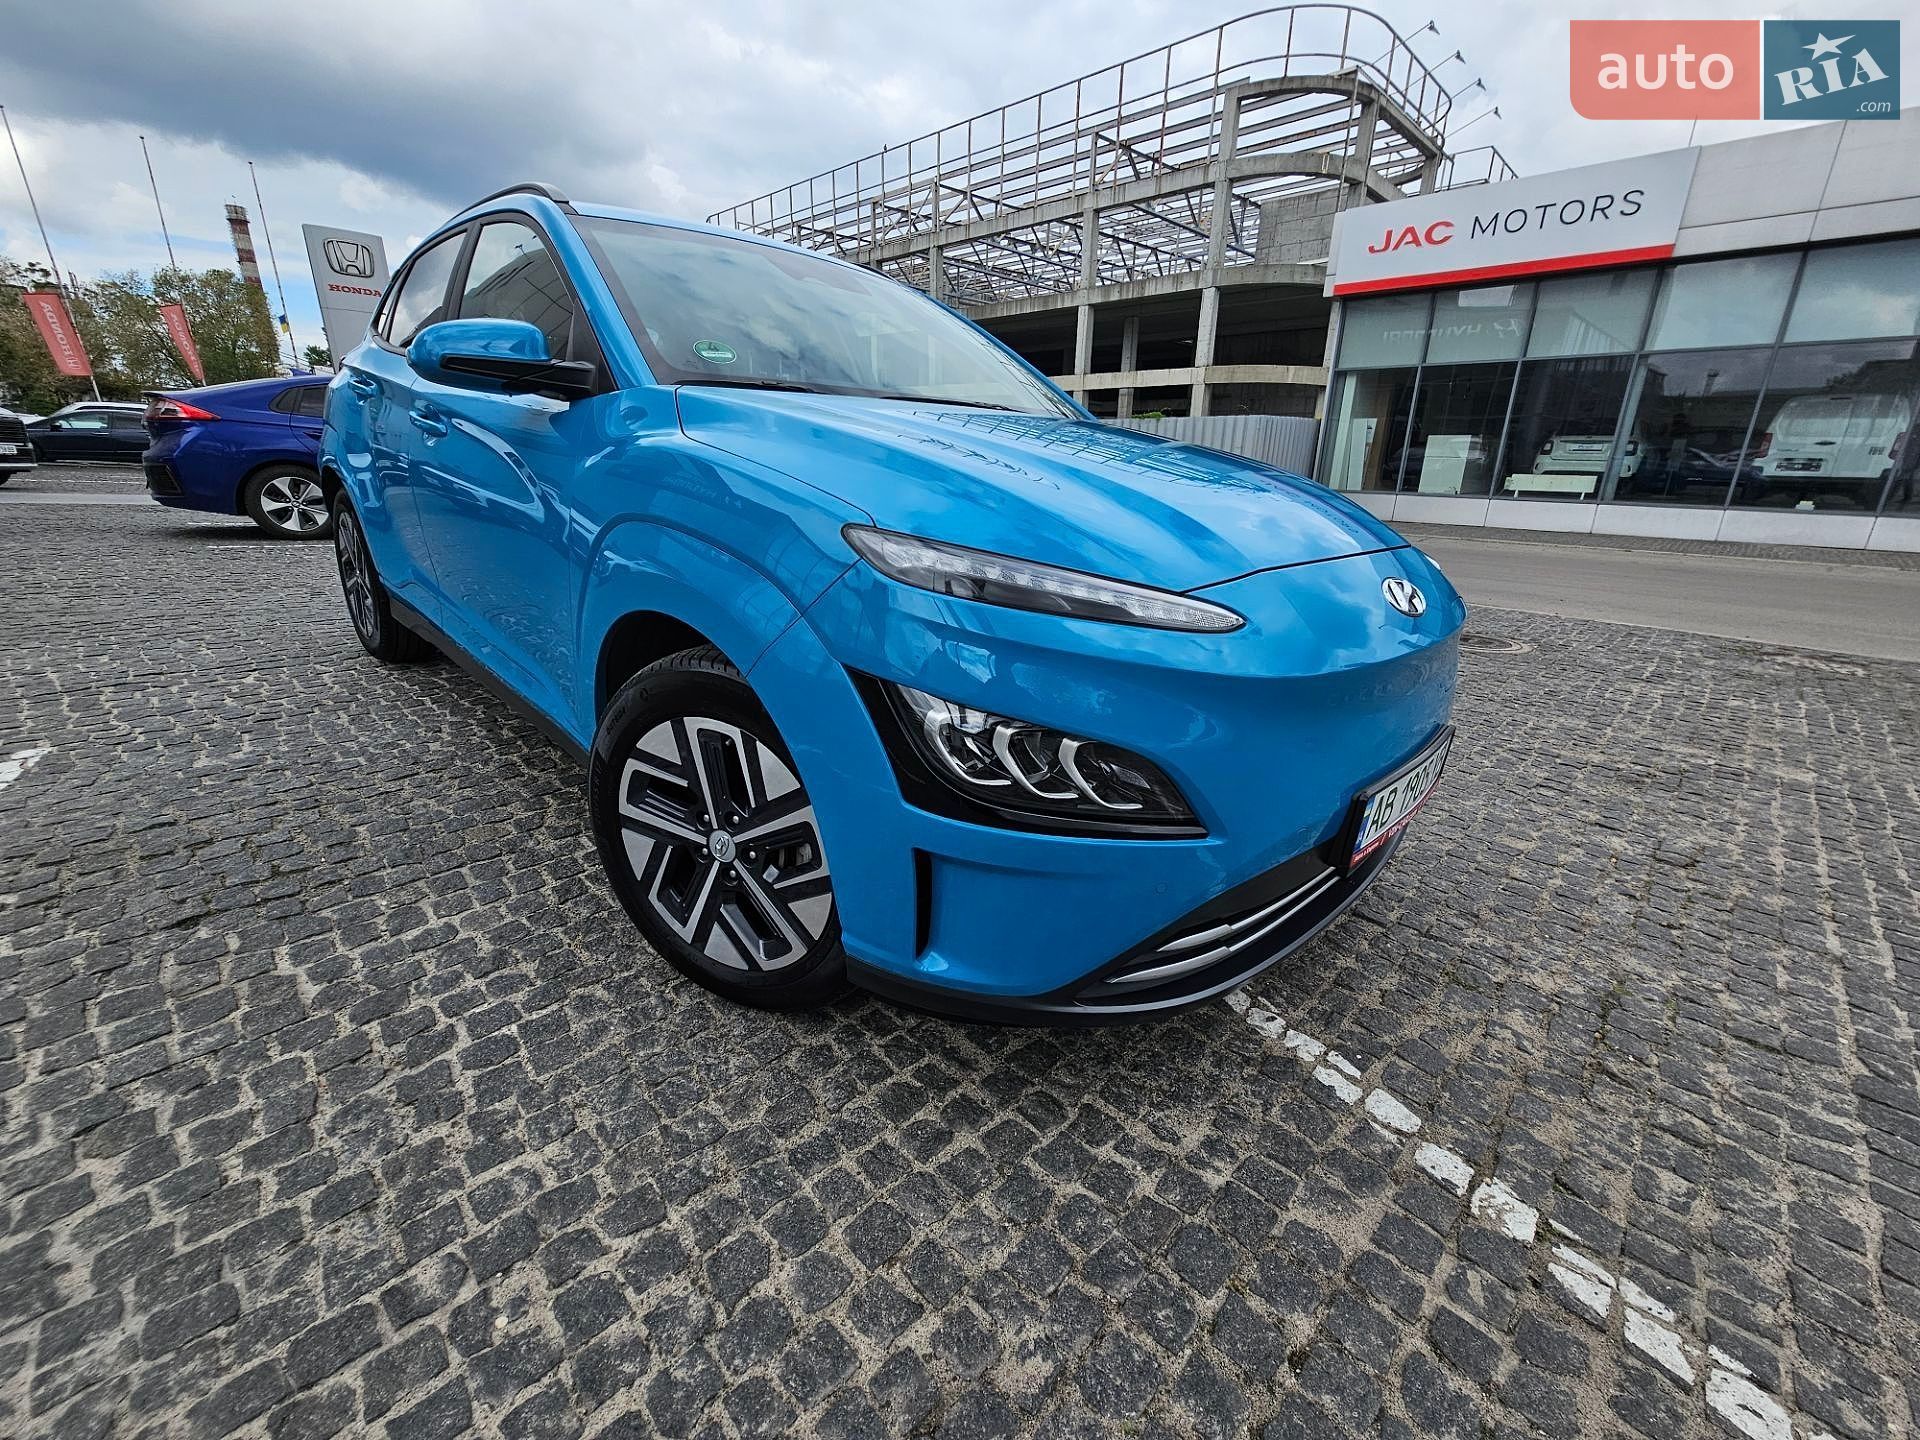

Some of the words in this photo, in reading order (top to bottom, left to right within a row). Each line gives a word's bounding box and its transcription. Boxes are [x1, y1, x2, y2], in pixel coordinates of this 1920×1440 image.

[1368, 220, 1455, 254] JAC
[1470, 189, 1645, 240] MOTORS
[327, 283, 382, 297] HONDA
[1365, 786, 1399, 840] AB
